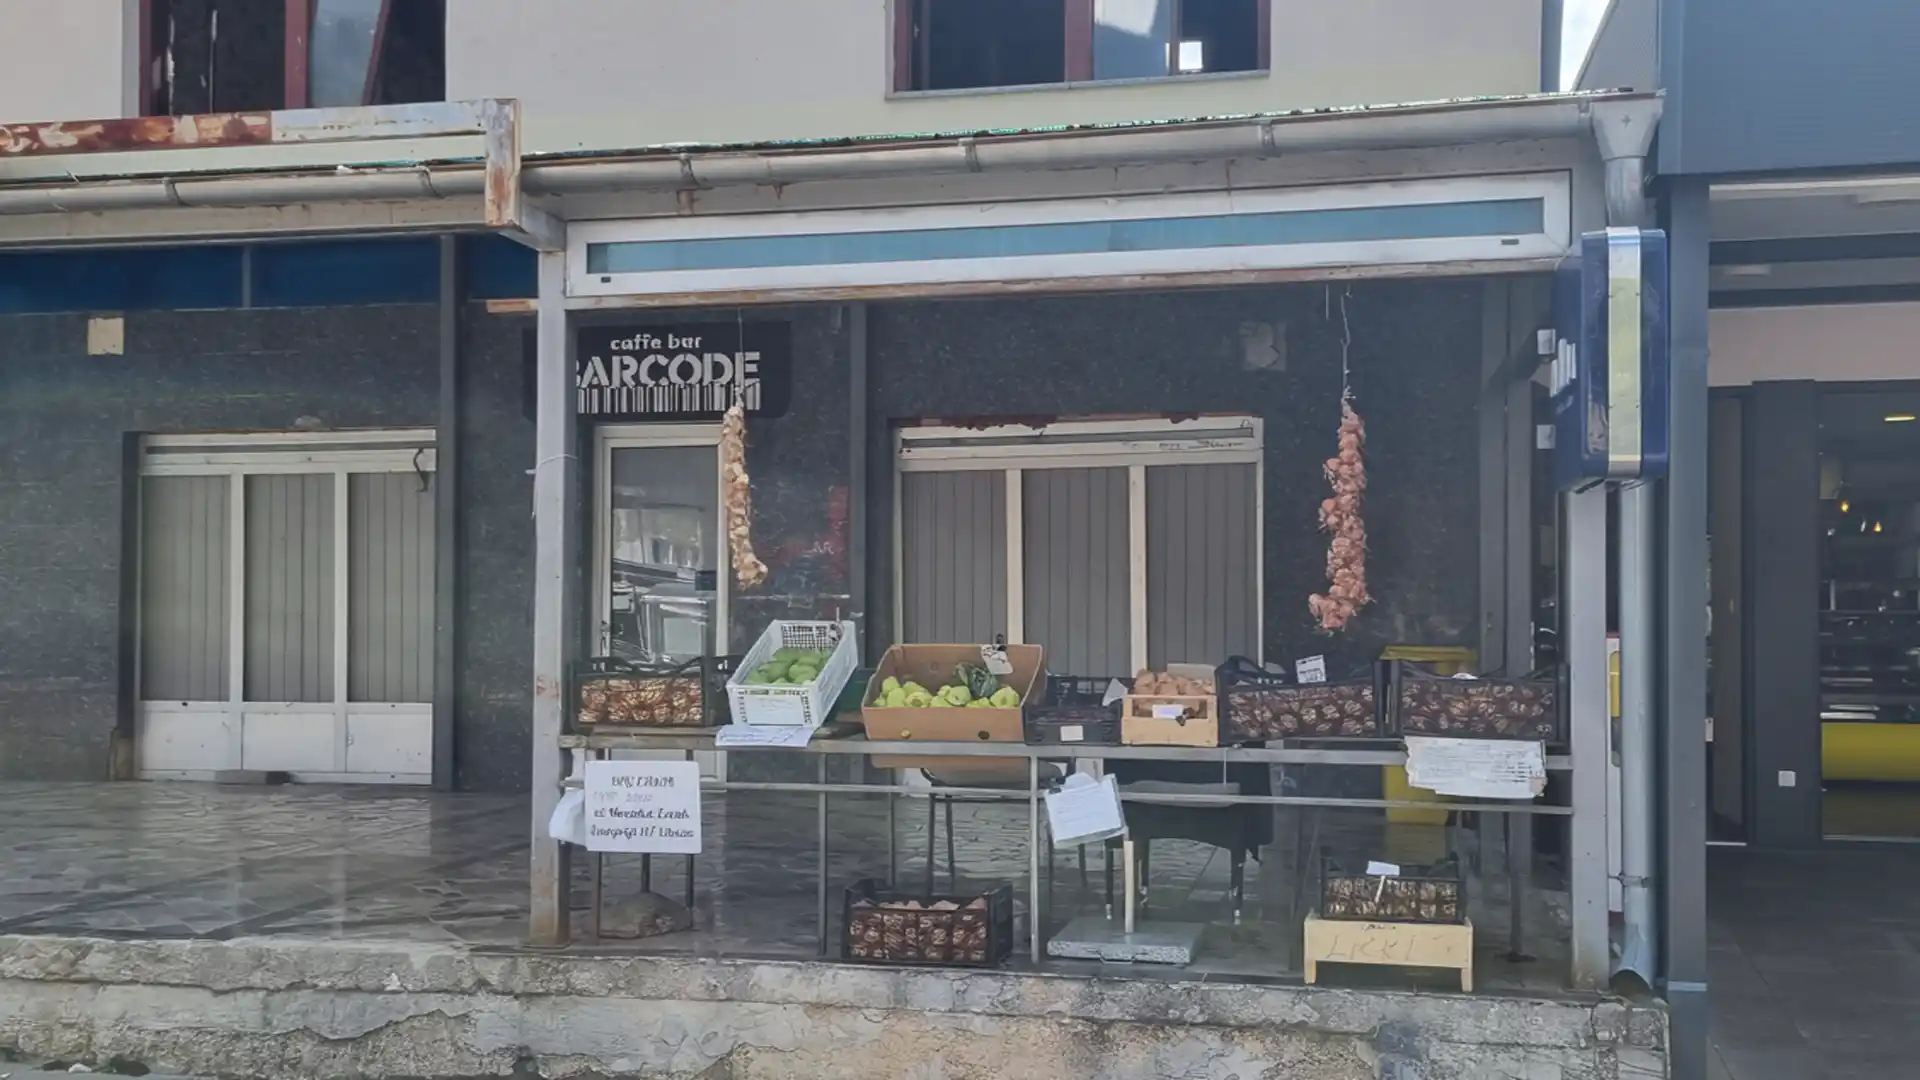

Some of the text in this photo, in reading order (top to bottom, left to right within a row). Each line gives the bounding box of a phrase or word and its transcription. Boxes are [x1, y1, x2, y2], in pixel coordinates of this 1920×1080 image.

[610, 333, 703, 351] caffe bar
[576, 351, 761, 389] ARCODE
